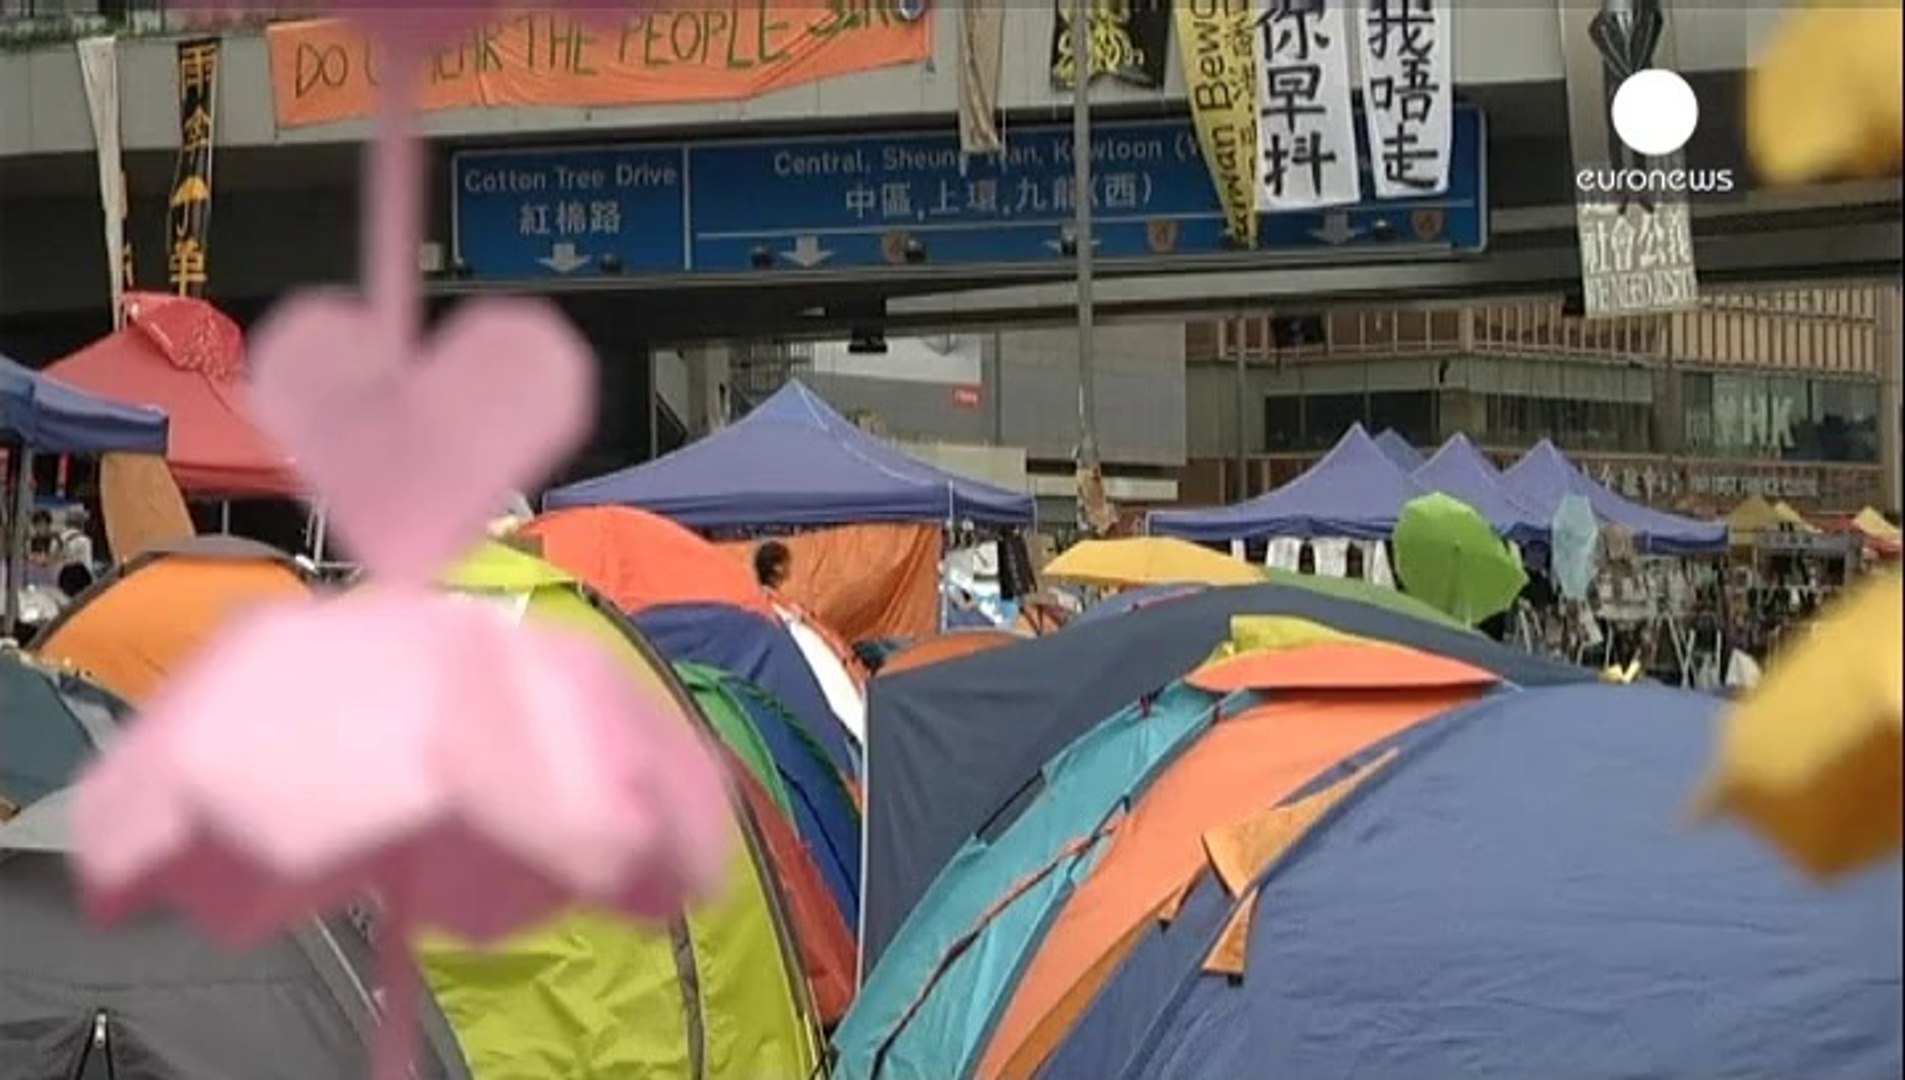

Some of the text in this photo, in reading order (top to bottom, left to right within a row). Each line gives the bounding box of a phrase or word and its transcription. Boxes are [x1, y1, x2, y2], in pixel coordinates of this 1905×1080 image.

[296, 43, 347, 99] DO
[514, 10, 598, 75] THE
[618, 0, 791, 68] PEOPLE
[464, 163, 678, 191] Cotton Tree Drive
